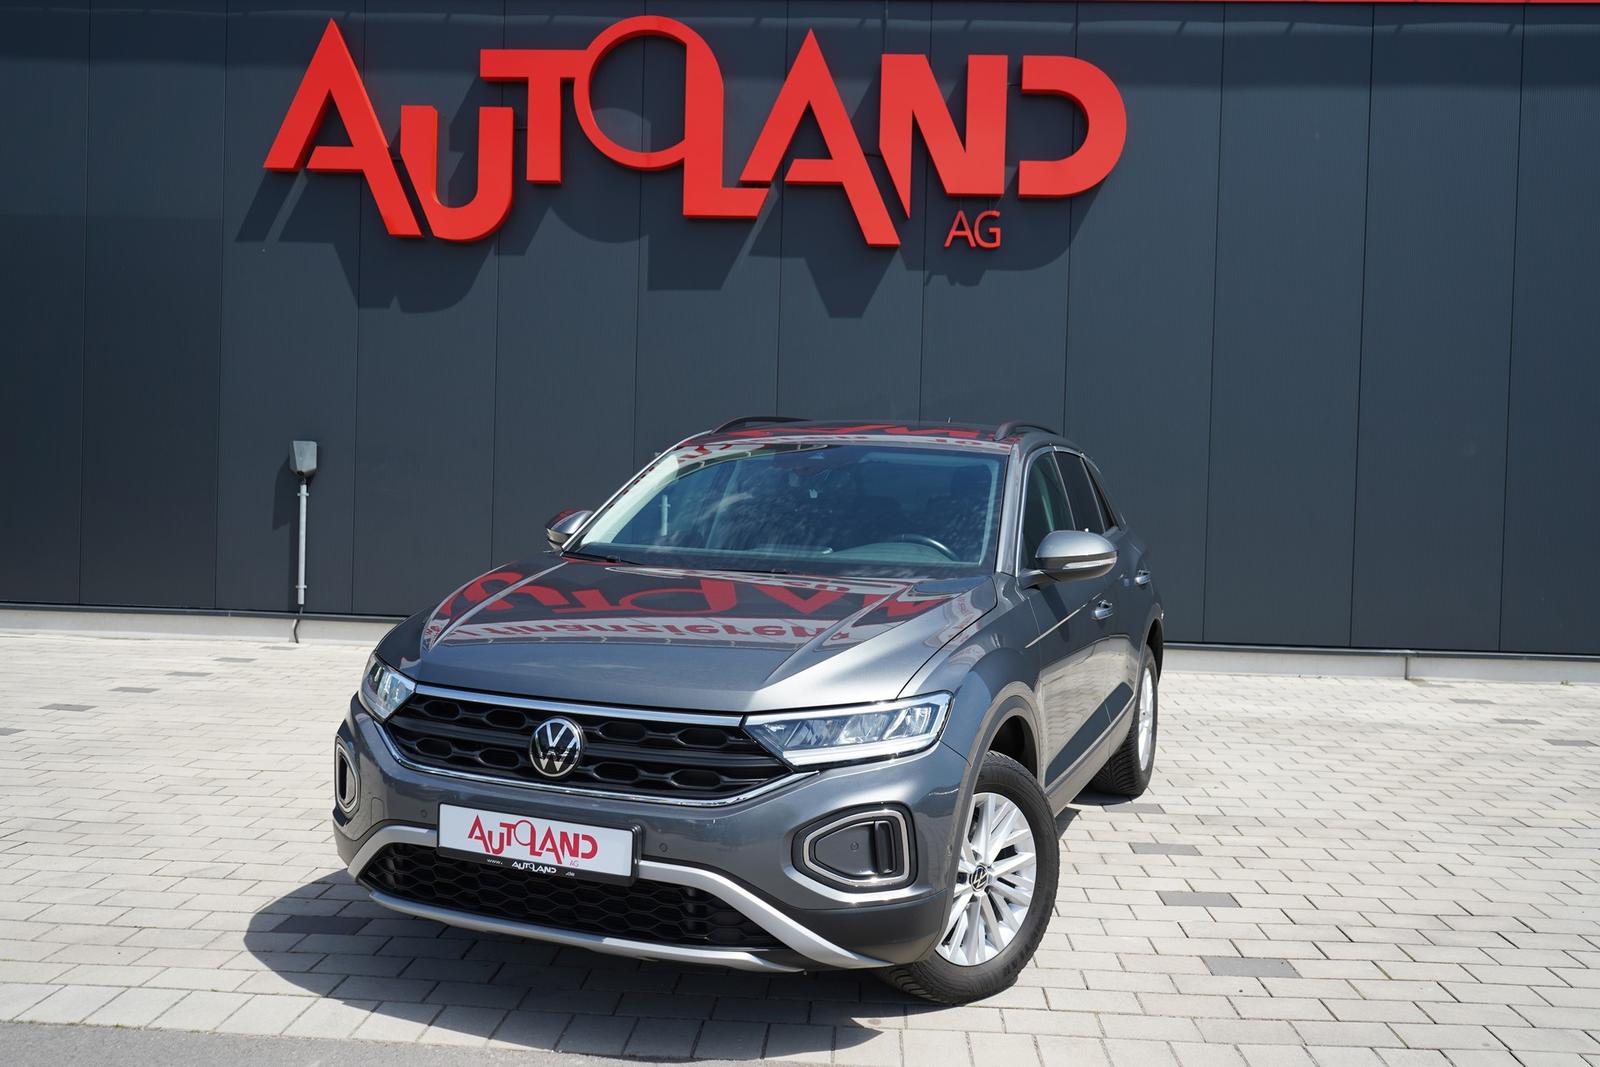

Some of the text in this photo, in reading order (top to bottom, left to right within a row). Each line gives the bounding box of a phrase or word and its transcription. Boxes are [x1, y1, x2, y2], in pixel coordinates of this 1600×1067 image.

[264, 15, 1127, 247] AUTOLAND
[944, 210, 1002, 249] AG
[467, 814, 598, 865] AUTOLAND
[511, 861, 557, 874] AUTOLAND
